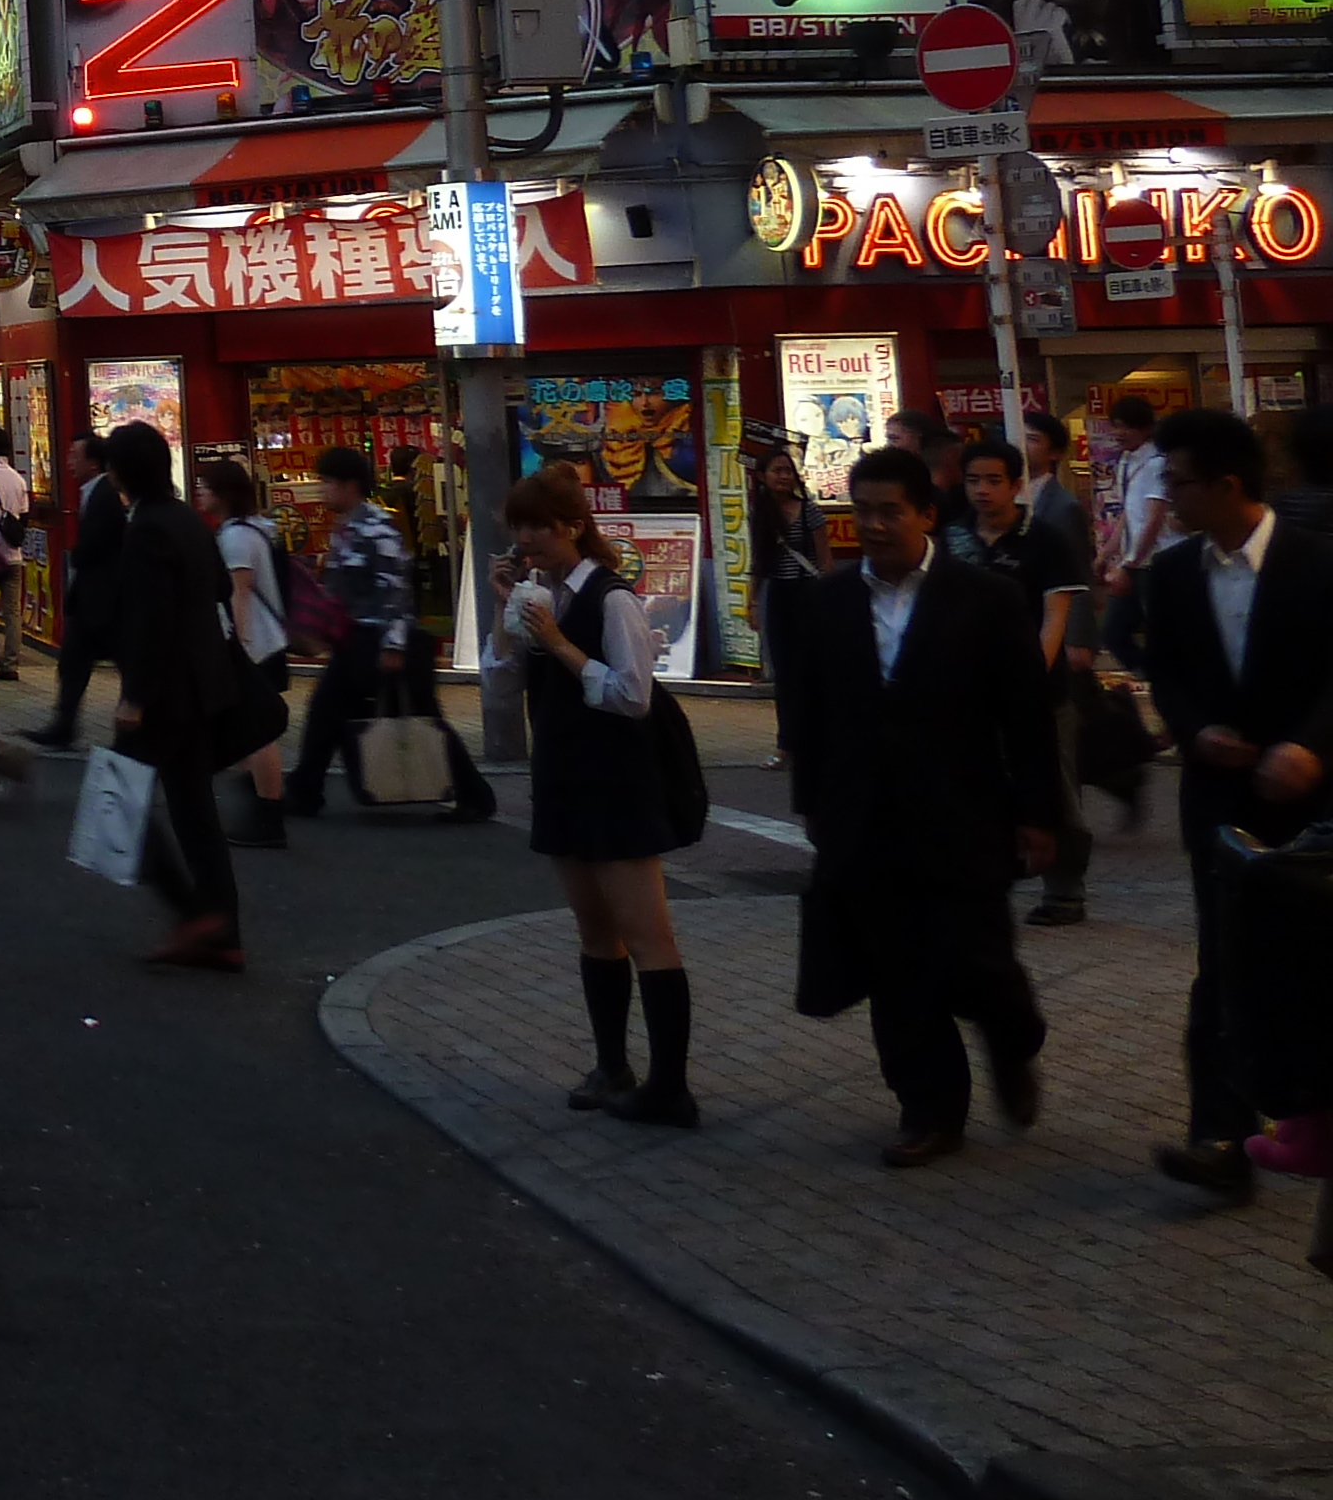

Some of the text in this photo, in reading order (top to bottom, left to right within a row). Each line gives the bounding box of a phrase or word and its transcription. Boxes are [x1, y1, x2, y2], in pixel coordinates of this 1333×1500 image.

[929, 122, 1021, 150] 自転車を除く
[1036, 127, 1207, 151] B/STATION
[448, 189, 460, 208] A
[800, 186, 1323, 270] PACIKO
[1109, 275, 1170, 296] 自転車を除く
[788, 352, 873, 375] REI=out
